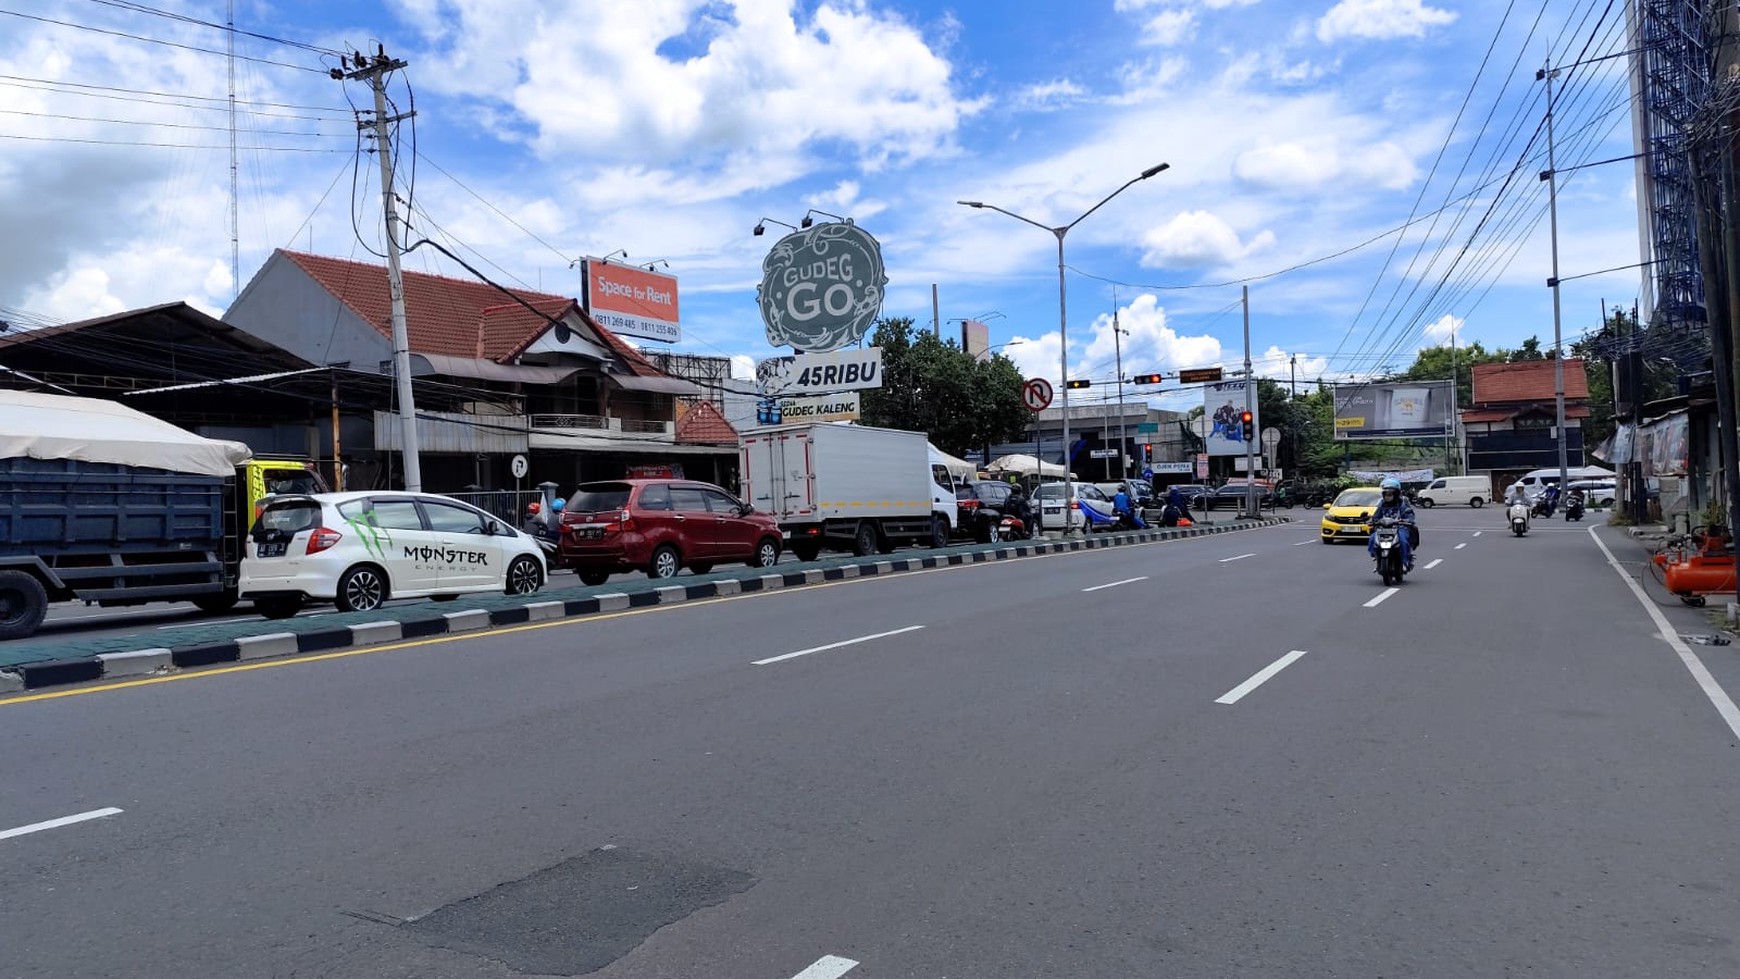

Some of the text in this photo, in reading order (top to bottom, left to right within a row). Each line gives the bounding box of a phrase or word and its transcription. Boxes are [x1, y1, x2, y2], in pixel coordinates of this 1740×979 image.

[783, 253, 853, 288] GUDEG
[597, 275, 671, 306] Space for Rent
[786, 281, 854, 321] GO
[595, 313, 611, 326] 0811
[611, 316, 624, 328] 269
[797, 361, 876, 387] 45RIBU
[782, 402, 855, 417] GUDEG KALENG
[404, 545, 488, 566] MONSTER
